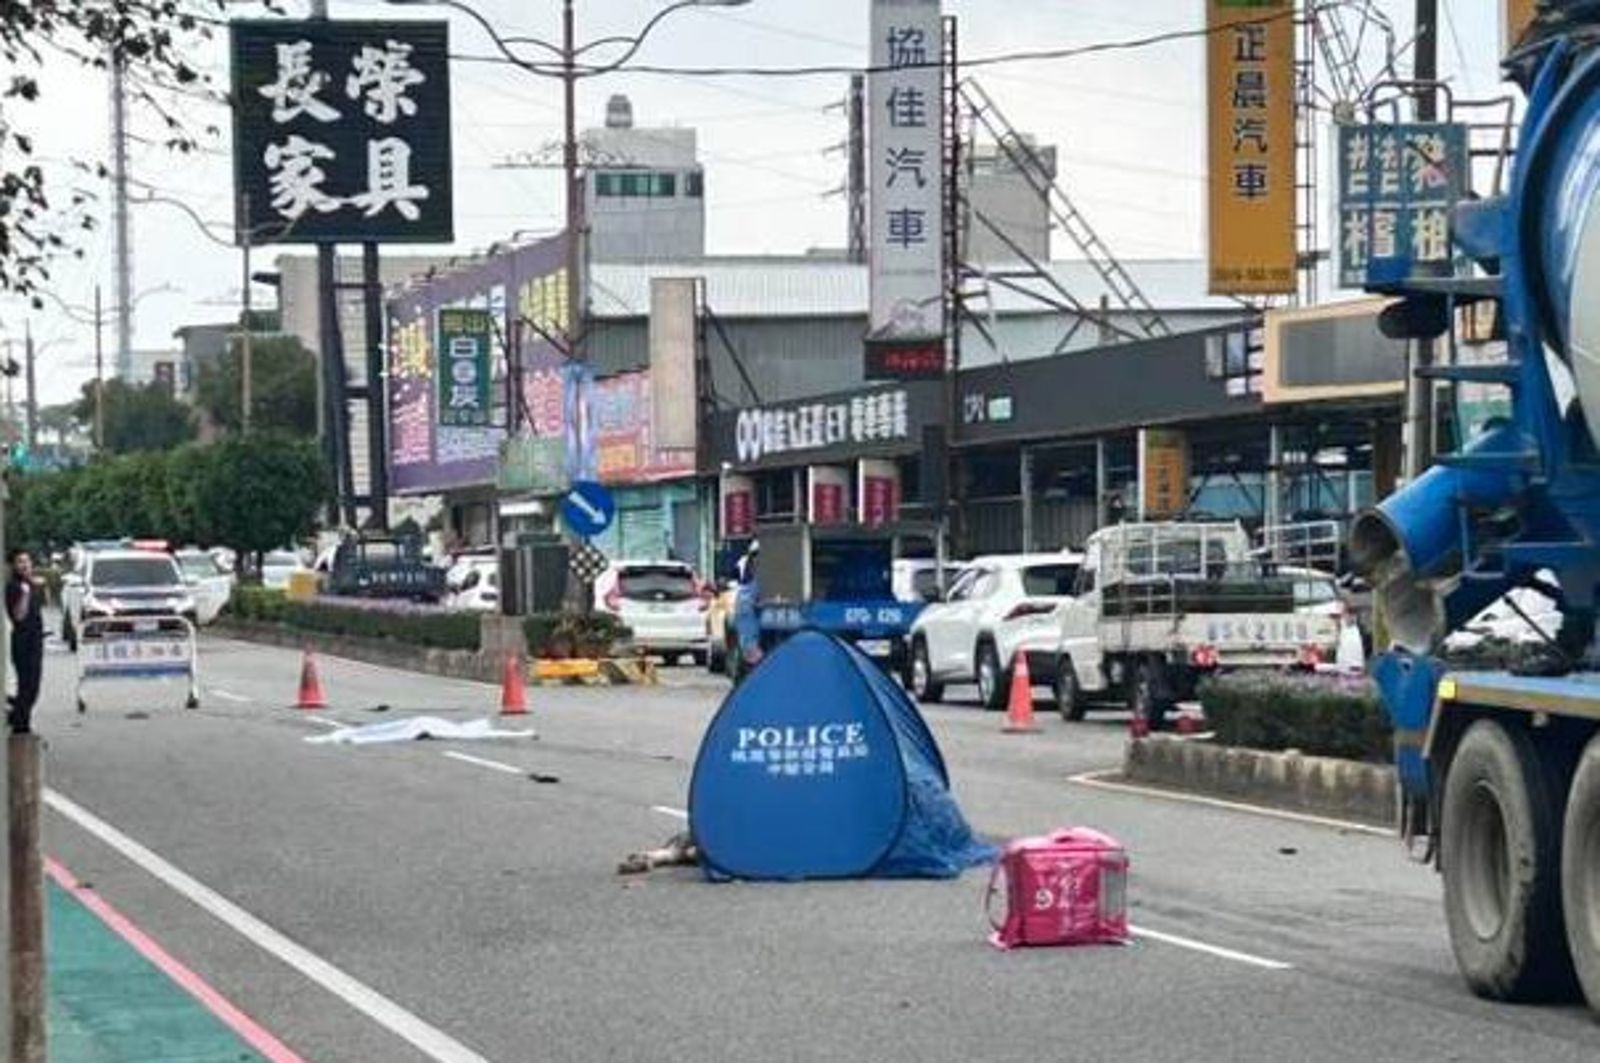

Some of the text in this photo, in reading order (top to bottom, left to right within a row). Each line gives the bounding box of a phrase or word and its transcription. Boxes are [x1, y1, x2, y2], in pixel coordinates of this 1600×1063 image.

[258, 39, 427, 123] 長榮
[1233, 25, 1268, 200] 正晨汽車
[264, 134, 430, 221] 家具
[885, 26, 927, 250] 協佳汽車
[738, 722, 865, 749] POLICE
